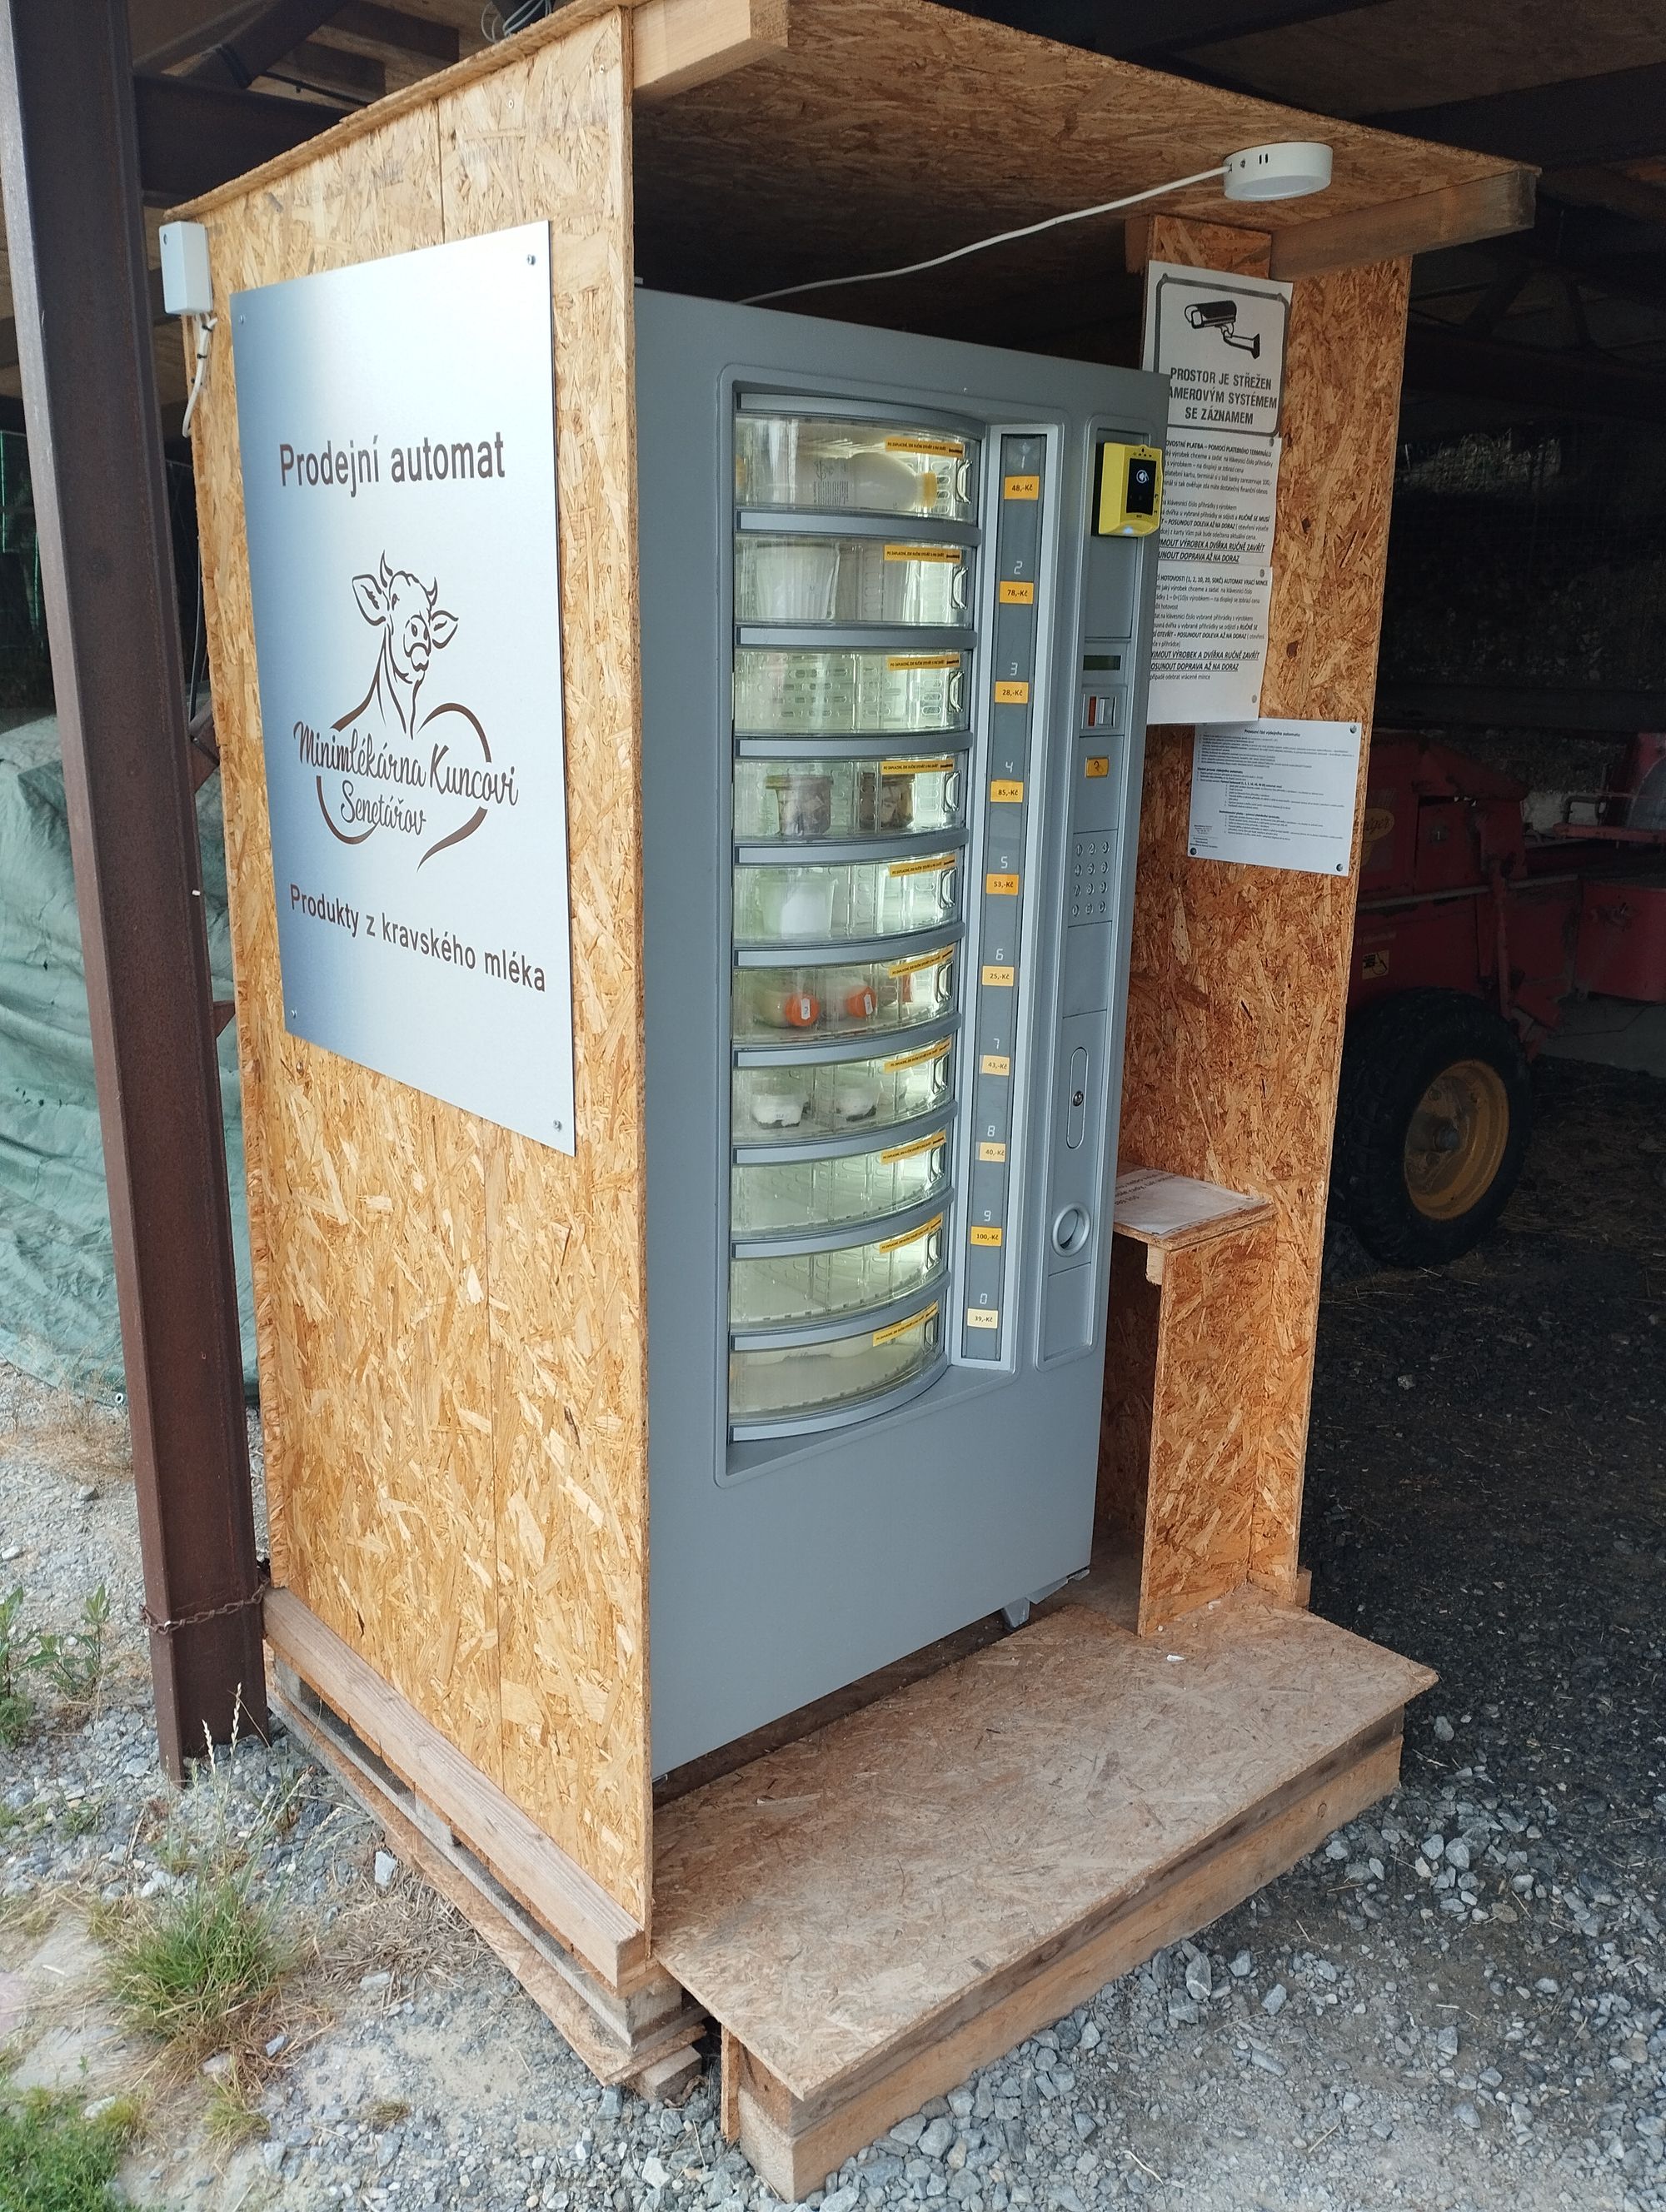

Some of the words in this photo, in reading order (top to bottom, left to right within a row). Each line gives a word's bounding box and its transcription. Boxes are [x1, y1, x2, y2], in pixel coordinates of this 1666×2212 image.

[1170, 367, 1216, 385] PROSTOR
[1219, 372, 1230, 386] JE
[1233, 371, 1272, 390] STŘEŽEN
[1169, 386, 1225, 404] AMEROVÝM
[1229, 391, 1278, 409] SYSTÉMEM
[1185, 406, 1198, 420] SE
[1201, 405, 1254, 425] ZÁZNAMEM
[279, 434, 380, 498] Prodejní
[391, 431, 506, 483] automat
[1011, 484, 1033, 492] 48,-Kč
[1159, 539, 1179, 547] MOUT
[1180, 538, 1205, 548] VÝROBEK
[1210, 541, 1228, 550] DVÍŘKA
[1229, 541, 1246, 551] RUČNĚ
[1247, 542, 1265, 551] ZAVŘÍT
[1205, 552, 1213, 560] AŽ
[1014, 560, 1023, 575] 2
[1007, 589, 1028, 597] 78,-Kč
[1173, 649, 1198, 658] VÝROBEK
[1203, 649, 1224, 659] DVÍŘKA
[1225, 650, 1242, 659] RUČNĚ
[1242, 650, 1260, 659] ZAVŘÍT
[1010, 662, 1018, 676] 3
[1204, 661, 1212, 670] AŽ
[293, 720, 426, 788] Minimlékárna
[429, 743, 519, 806] Kuncovi
[1005, 761, 1014, 774] 4
[998, 788, 1019, 796] 85,-Kč
[340, 780, 427, 836] Senetářov
[1000, 855, 1009, 869] 5
[994, 880, 1014, 889] 53,-Kč
[290, 883, 359, 938] Produkty
[366, 914, 376, 937] z
[382, 912, 476, 970] kravského
[484, 949, 546, 993] mléka
[995, 949, 1004, 961] 6
[994, 1038, 1000, 1049] 7
[987, 1125, 995, 1137] 8
[984, 1210, 991, 1222] 9
[980, 1293, 988, 1304] 0
